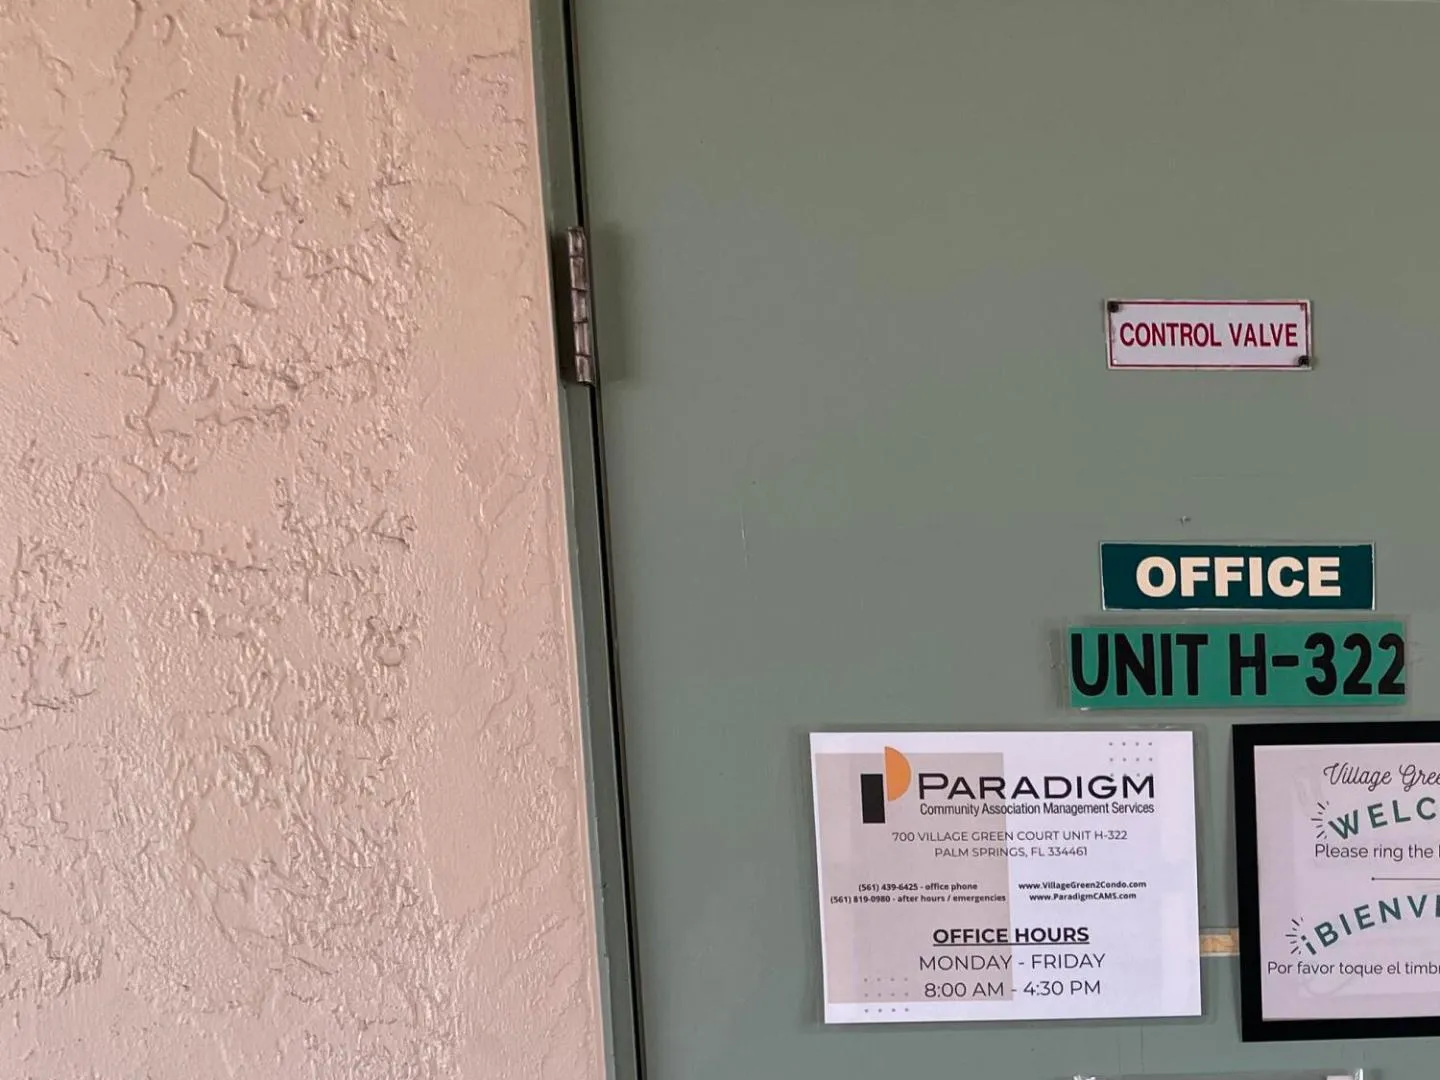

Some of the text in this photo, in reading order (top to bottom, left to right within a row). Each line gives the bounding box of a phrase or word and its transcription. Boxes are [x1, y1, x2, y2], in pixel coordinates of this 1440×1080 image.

[1120, 322, 1298, 348] CONTROL VALVE
[1135, 555, 1342, 598] OFFICE
[1070, 631, 1406, 697] UNIT H-322
[1323, 761, 1393, 792] Village
[918, 772, 1155, 801] PARADIGM
[919, 801, 1155, 817] Community Association Management Services
[891, 829, 1128, 843] 700 VILLAGE GREEN COURT UNIT H-322
[934, 846, 1088, 859] PALM SPRINGS, FL 334461
[1314, 843, 1369, 860] Please
[1372, 844, 1404, 862] ring
[1407, 843, 1434, 860] the
[858, 882, 880, 893] (561)
[880, 881, 918, 892] 439-6425
[924, 882, 949, 891] office
[950, 882, 978, 893] phone
[1018, 880, 1147, 890] www.VillageGreen2Condo.com
[830, 894, 852, 905] (561)
[897, 894, 919, 903] after
[920, 894, 947, 903] hours
[952, 893, 1007, 905] emergencies
[1029, 891, 1137, 902] www.ParadigmCAMS.com
[932, 926, 1090, 944] OFFICE HOURS
[918, 953, 1013, 972] MONDAY
[1031, 952, 1107, 970] FRIDAY
[1267, 960, 1293, 976] Por
[1296, 959, 1336, 976] favor
[1338, 961, 1384, 979] toque
[1386, 959, 1402, 976] el
[923, 981, 967, 999] 8:00
[971, 980, 1005, 998] AM
[1022, 979, 1065, 997] 4:30
[1070, 979, 1102, 996] PM
